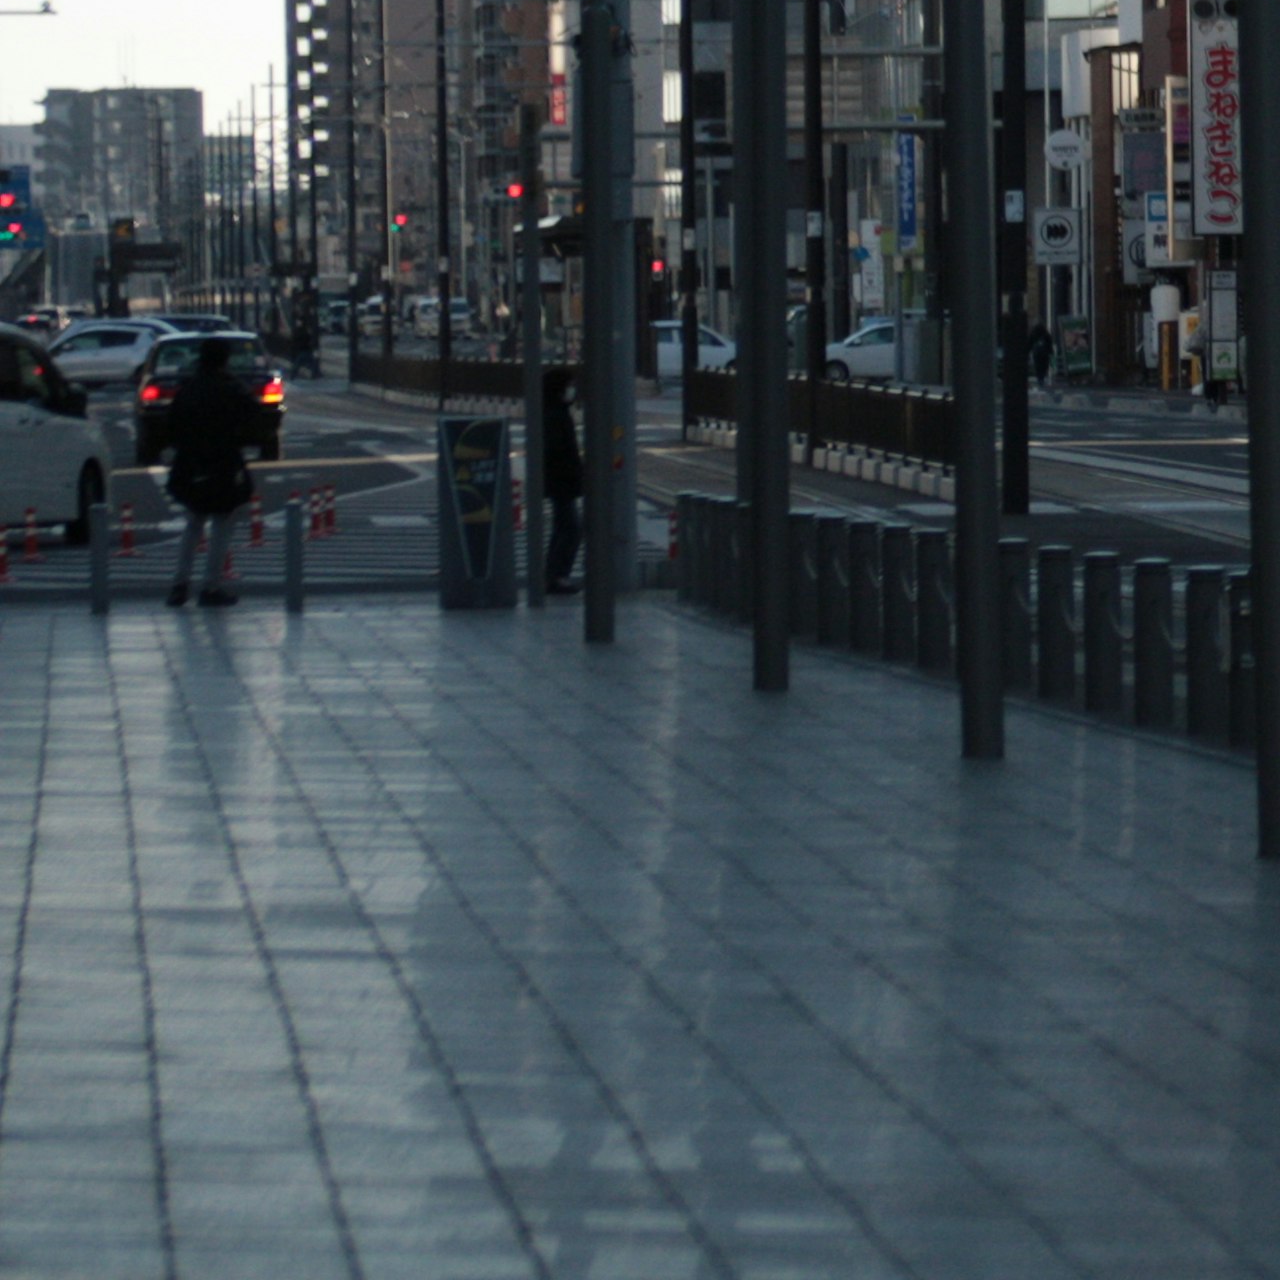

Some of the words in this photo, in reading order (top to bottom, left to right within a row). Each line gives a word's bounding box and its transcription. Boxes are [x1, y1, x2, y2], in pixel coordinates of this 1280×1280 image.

[1205, 45, 1240, 223] まねきねこ
